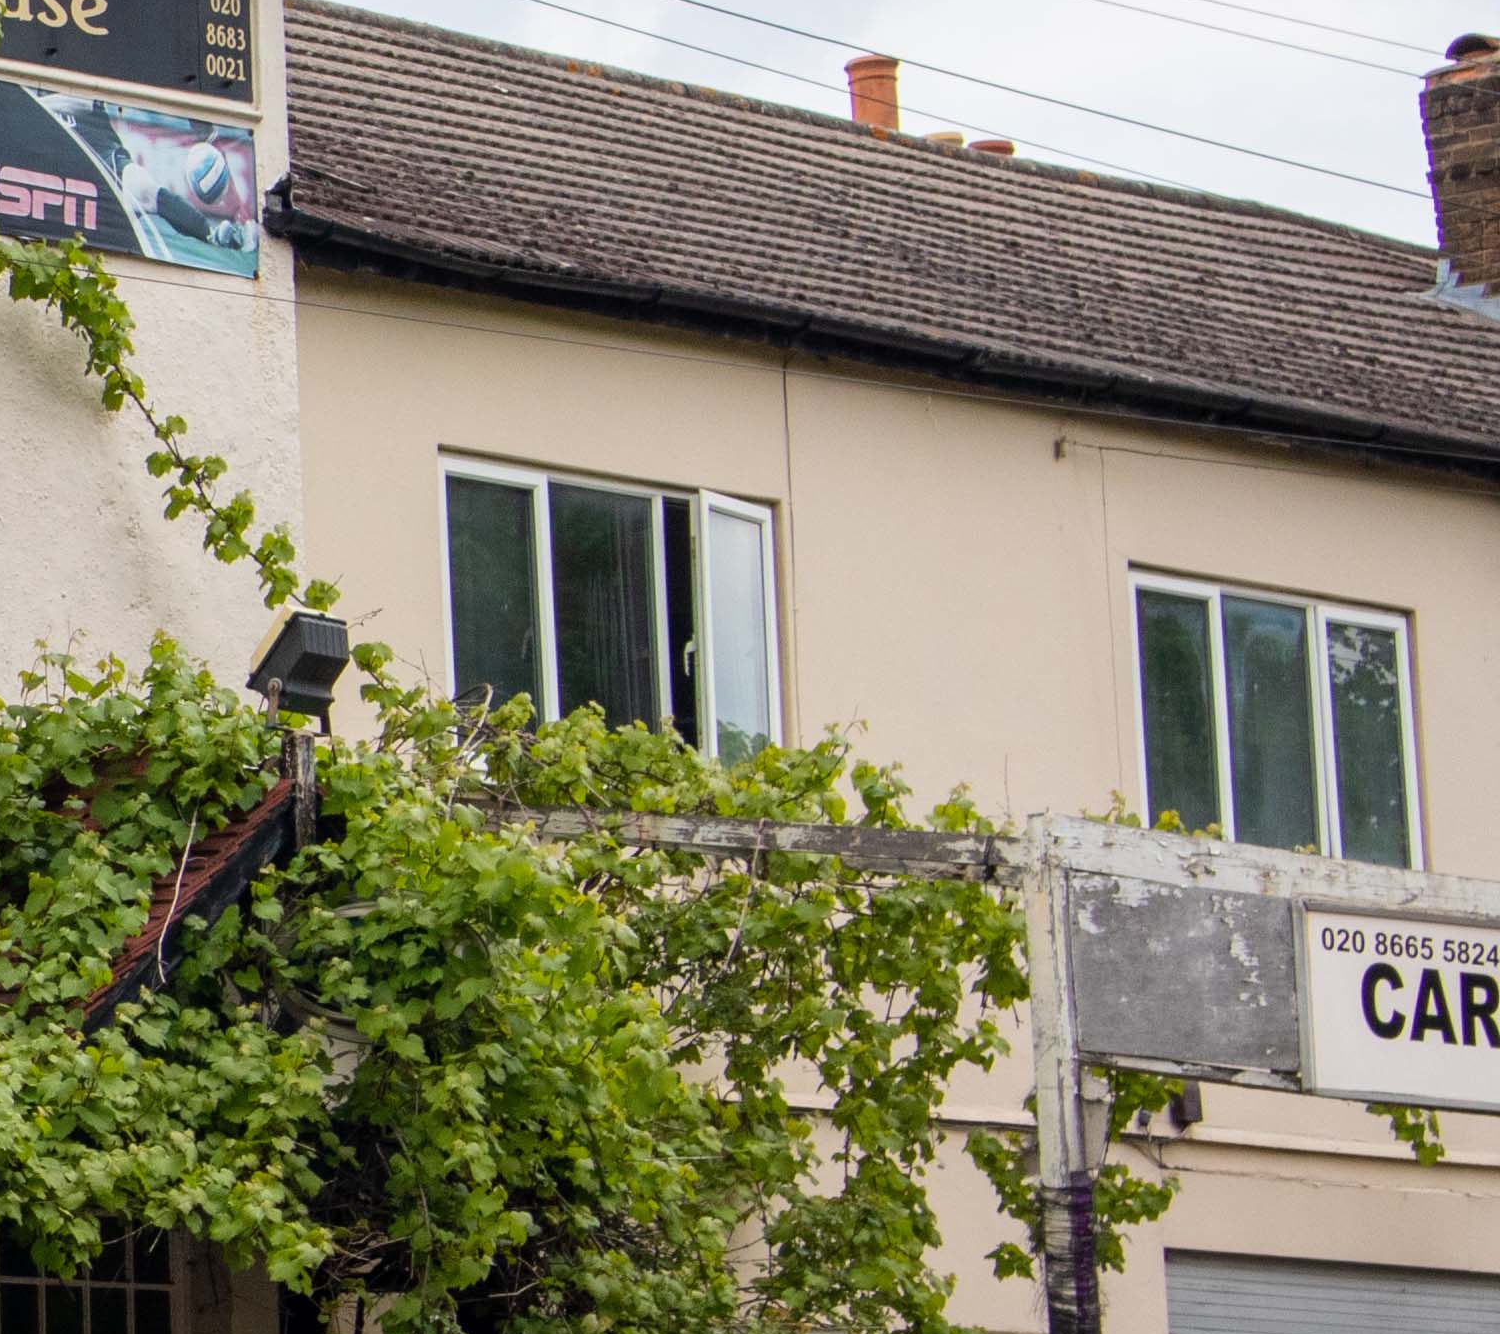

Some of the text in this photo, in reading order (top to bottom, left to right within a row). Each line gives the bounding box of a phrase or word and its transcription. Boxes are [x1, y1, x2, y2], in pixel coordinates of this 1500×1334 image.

[205, 21, 247, 52] 8683
[205, 51, 247, 83] 0021
[1321, 926, 1500, 968] 020 8665 5824
